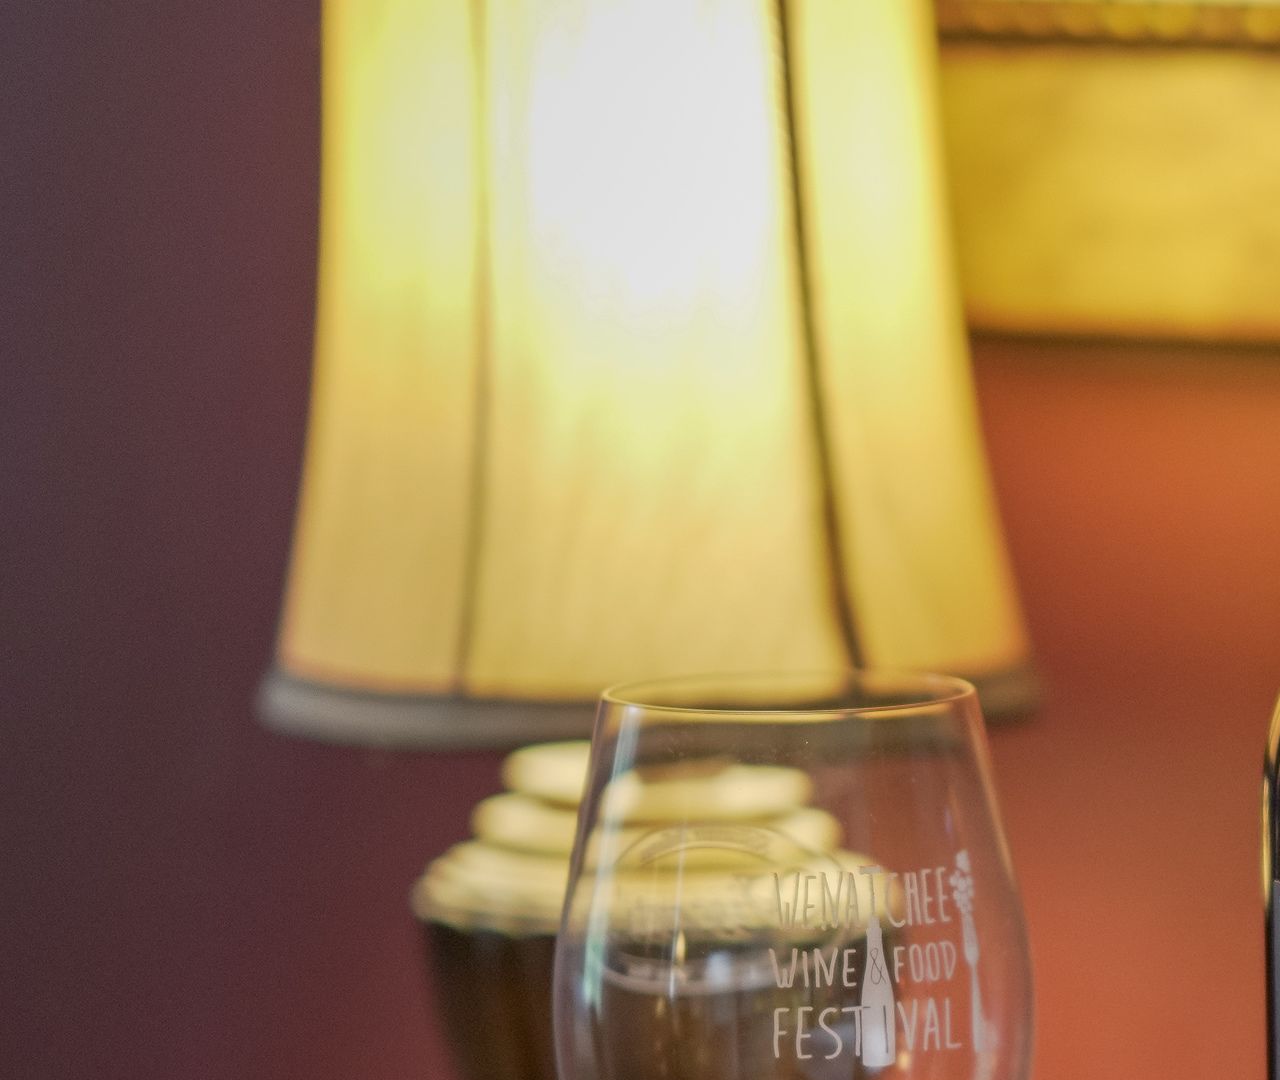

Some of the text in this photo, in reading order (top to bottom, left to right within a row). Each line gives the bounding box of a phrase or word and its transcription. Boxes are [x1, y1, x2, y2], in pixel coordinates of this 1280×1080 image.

[772, 864, 952, 931] WENATCHEE
[768, 941, 958, 989] WINE & FOOD
[772, 998, 963, 1060] FESTIVAL
